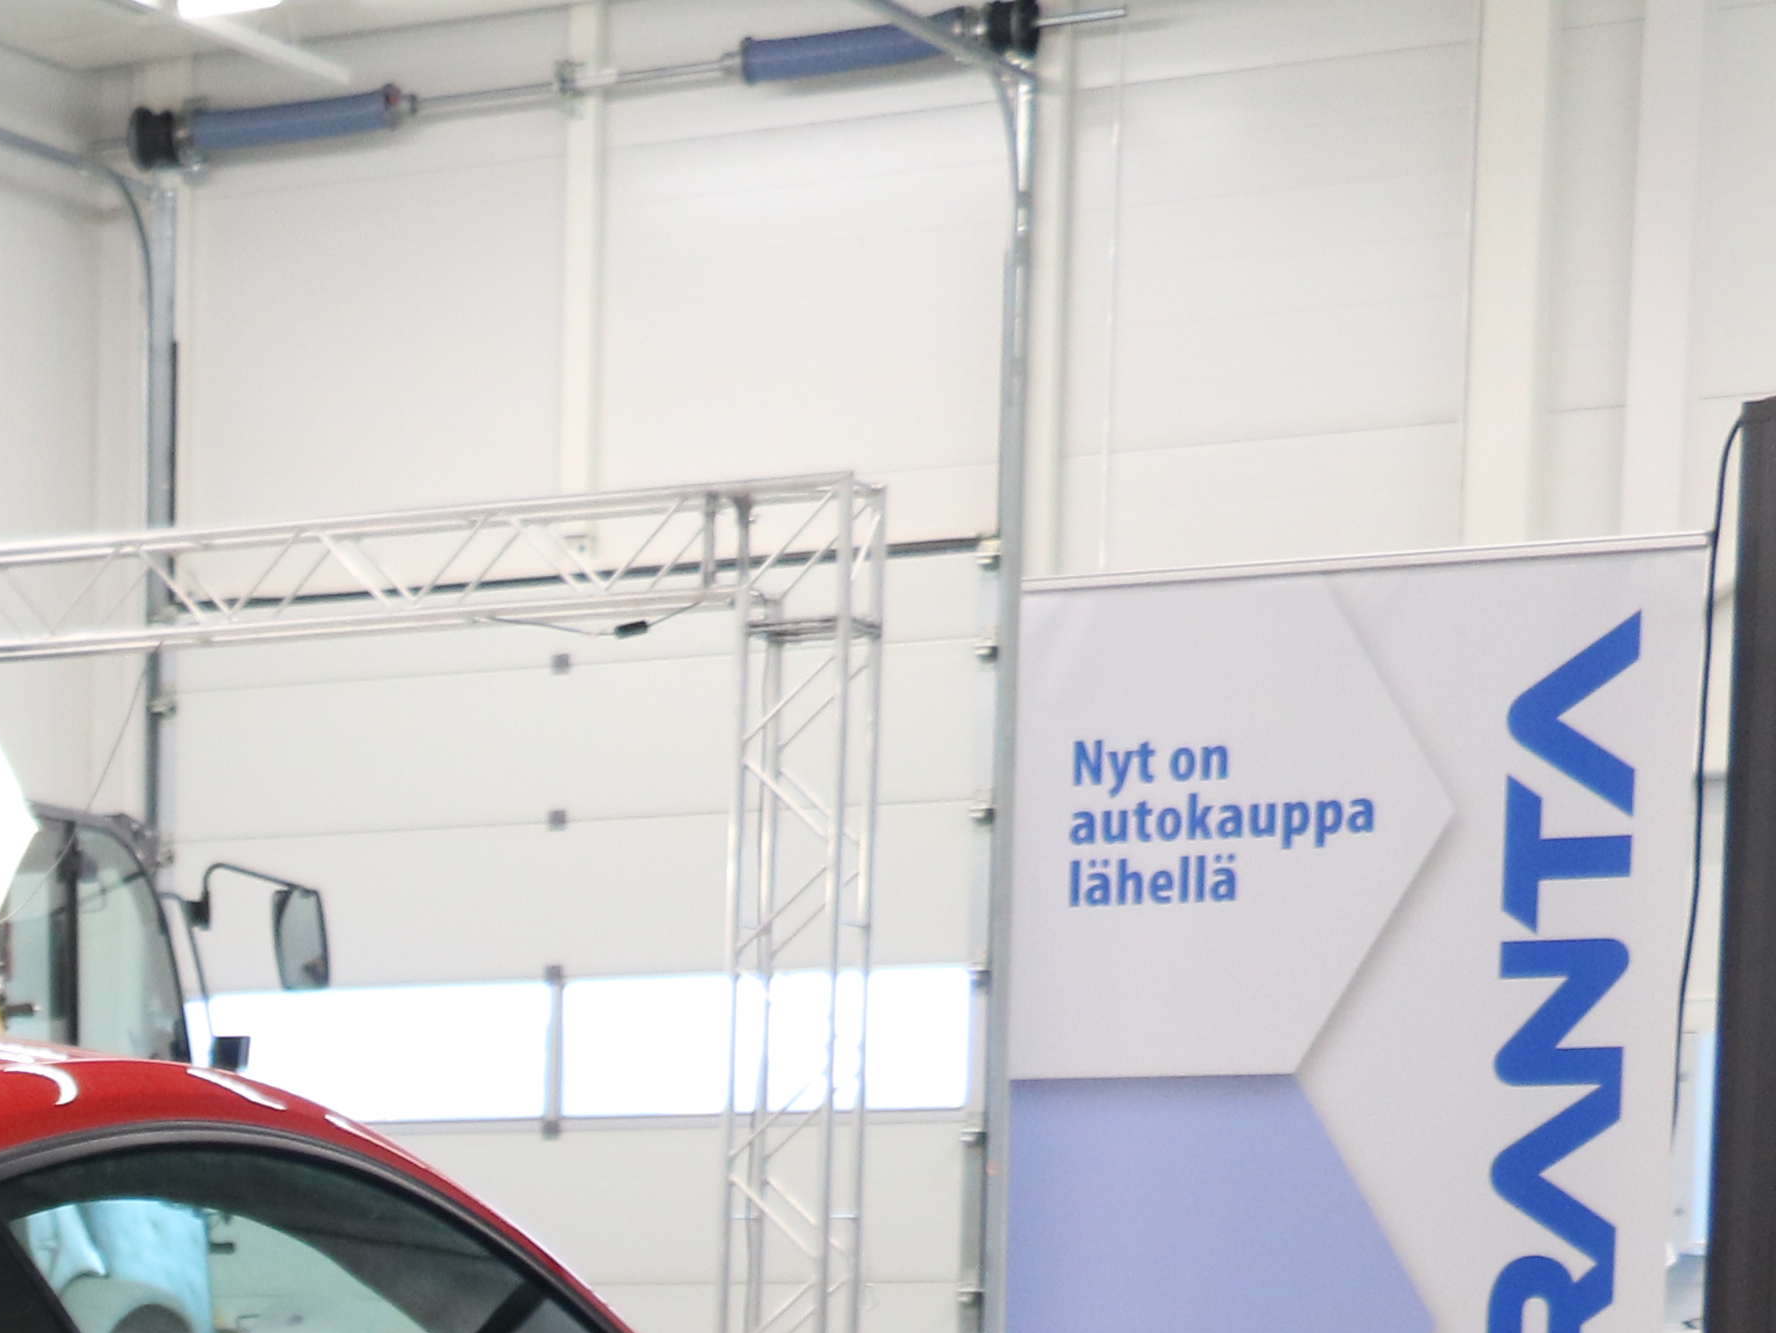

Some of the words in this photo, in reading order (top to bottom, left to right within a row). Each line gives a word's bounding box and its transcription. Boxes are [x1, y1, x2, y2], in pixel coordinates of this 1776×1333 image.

[1073, 739, 1157, 798] Nyt
[1169, 745, 1230, 782] on
[1069, 792, 1376, 850] autokauppa
[1069, 853, 1238, 907] lähellä
